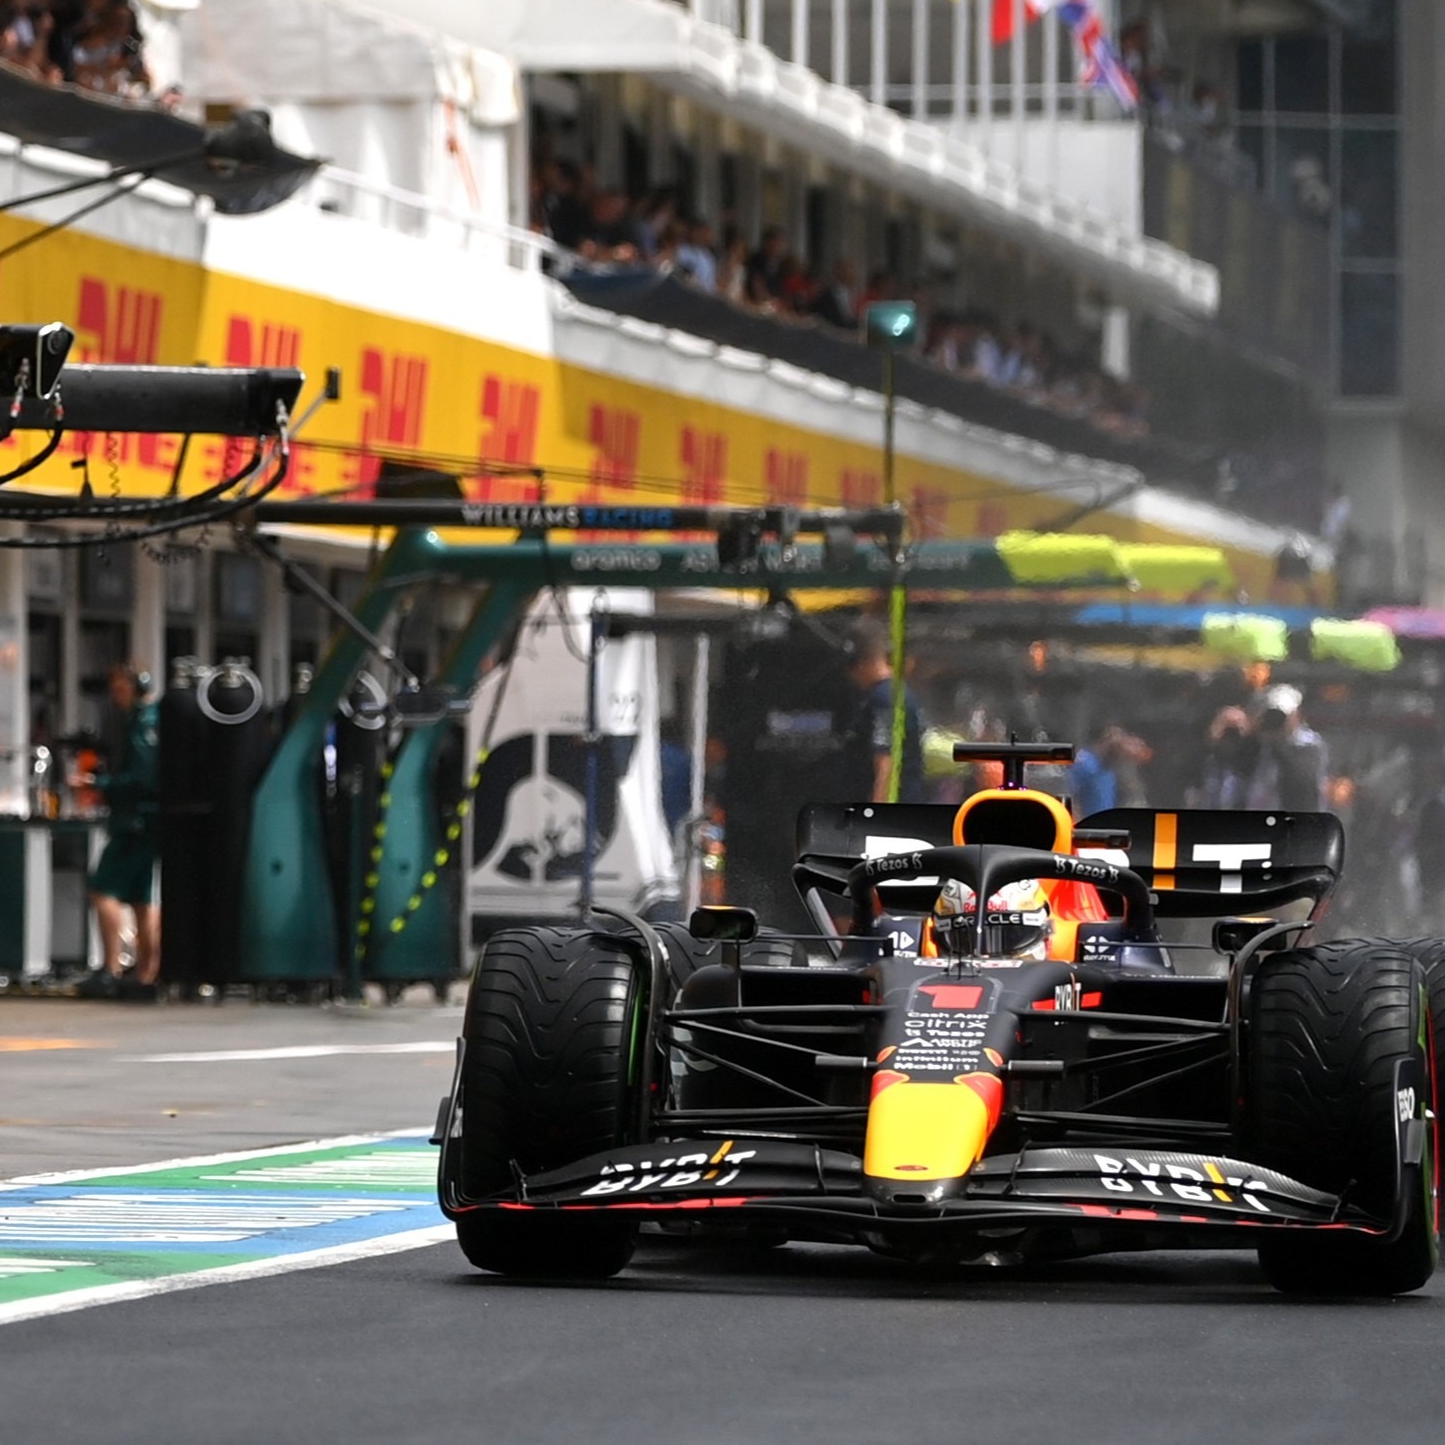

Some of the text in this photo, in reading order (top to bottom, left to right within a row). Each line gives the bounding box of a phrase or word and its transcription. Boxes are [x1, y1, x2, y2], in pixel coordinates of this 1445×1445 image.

[461, 505, 580, 528] WILLIAMS
[875, 856, 910, 872] Tezos
[1069, 861, 1108, 881] Tezos
[952, 914, 1021, 928] ORCLE
[918, 986, 984, 1009] 1
[1093, 1155, 1271, 1212] BYBIT
